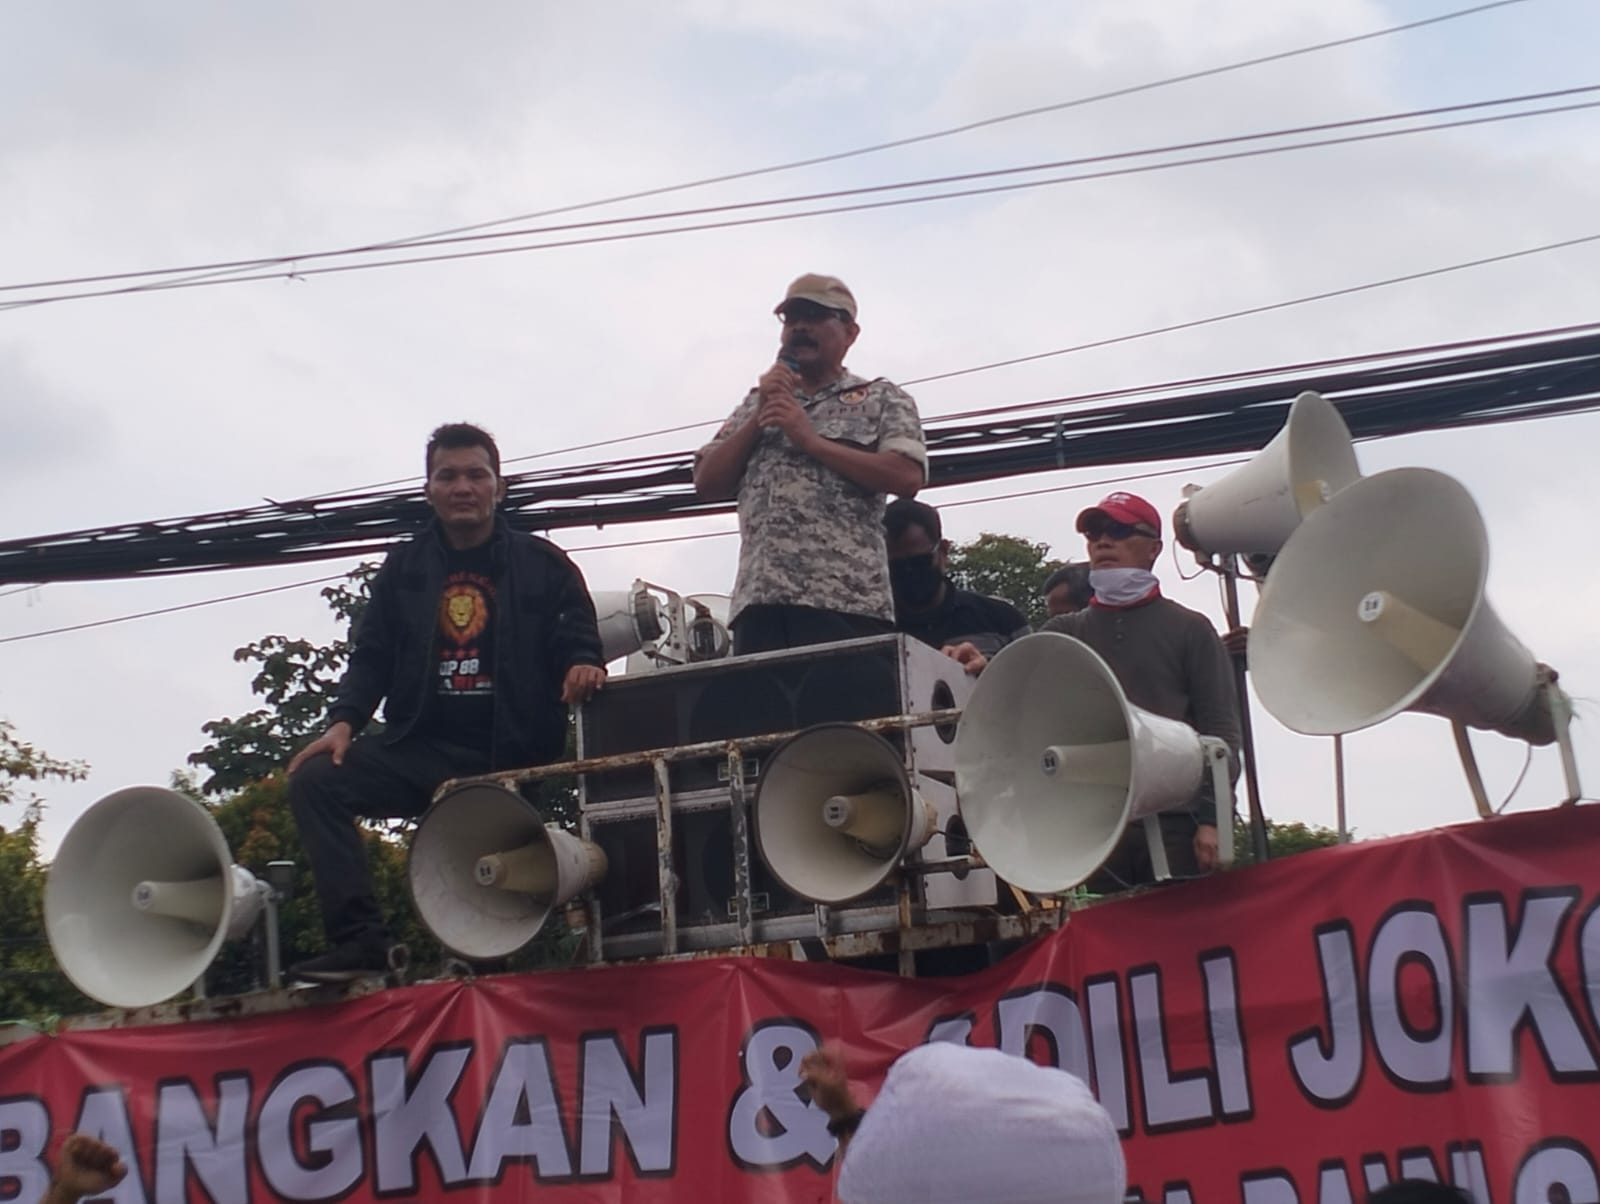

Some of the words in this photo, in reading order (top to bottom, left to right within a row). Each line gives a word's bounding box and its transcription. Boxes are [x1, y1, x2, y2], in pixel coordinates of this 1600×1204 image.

[0, 1025, 680, 1204] BANGKAN
[729, 1019, 840, 1172] &
[926, 946, 1254, 1139] DILI
[1287, 884, 1600, 1110] JOK
